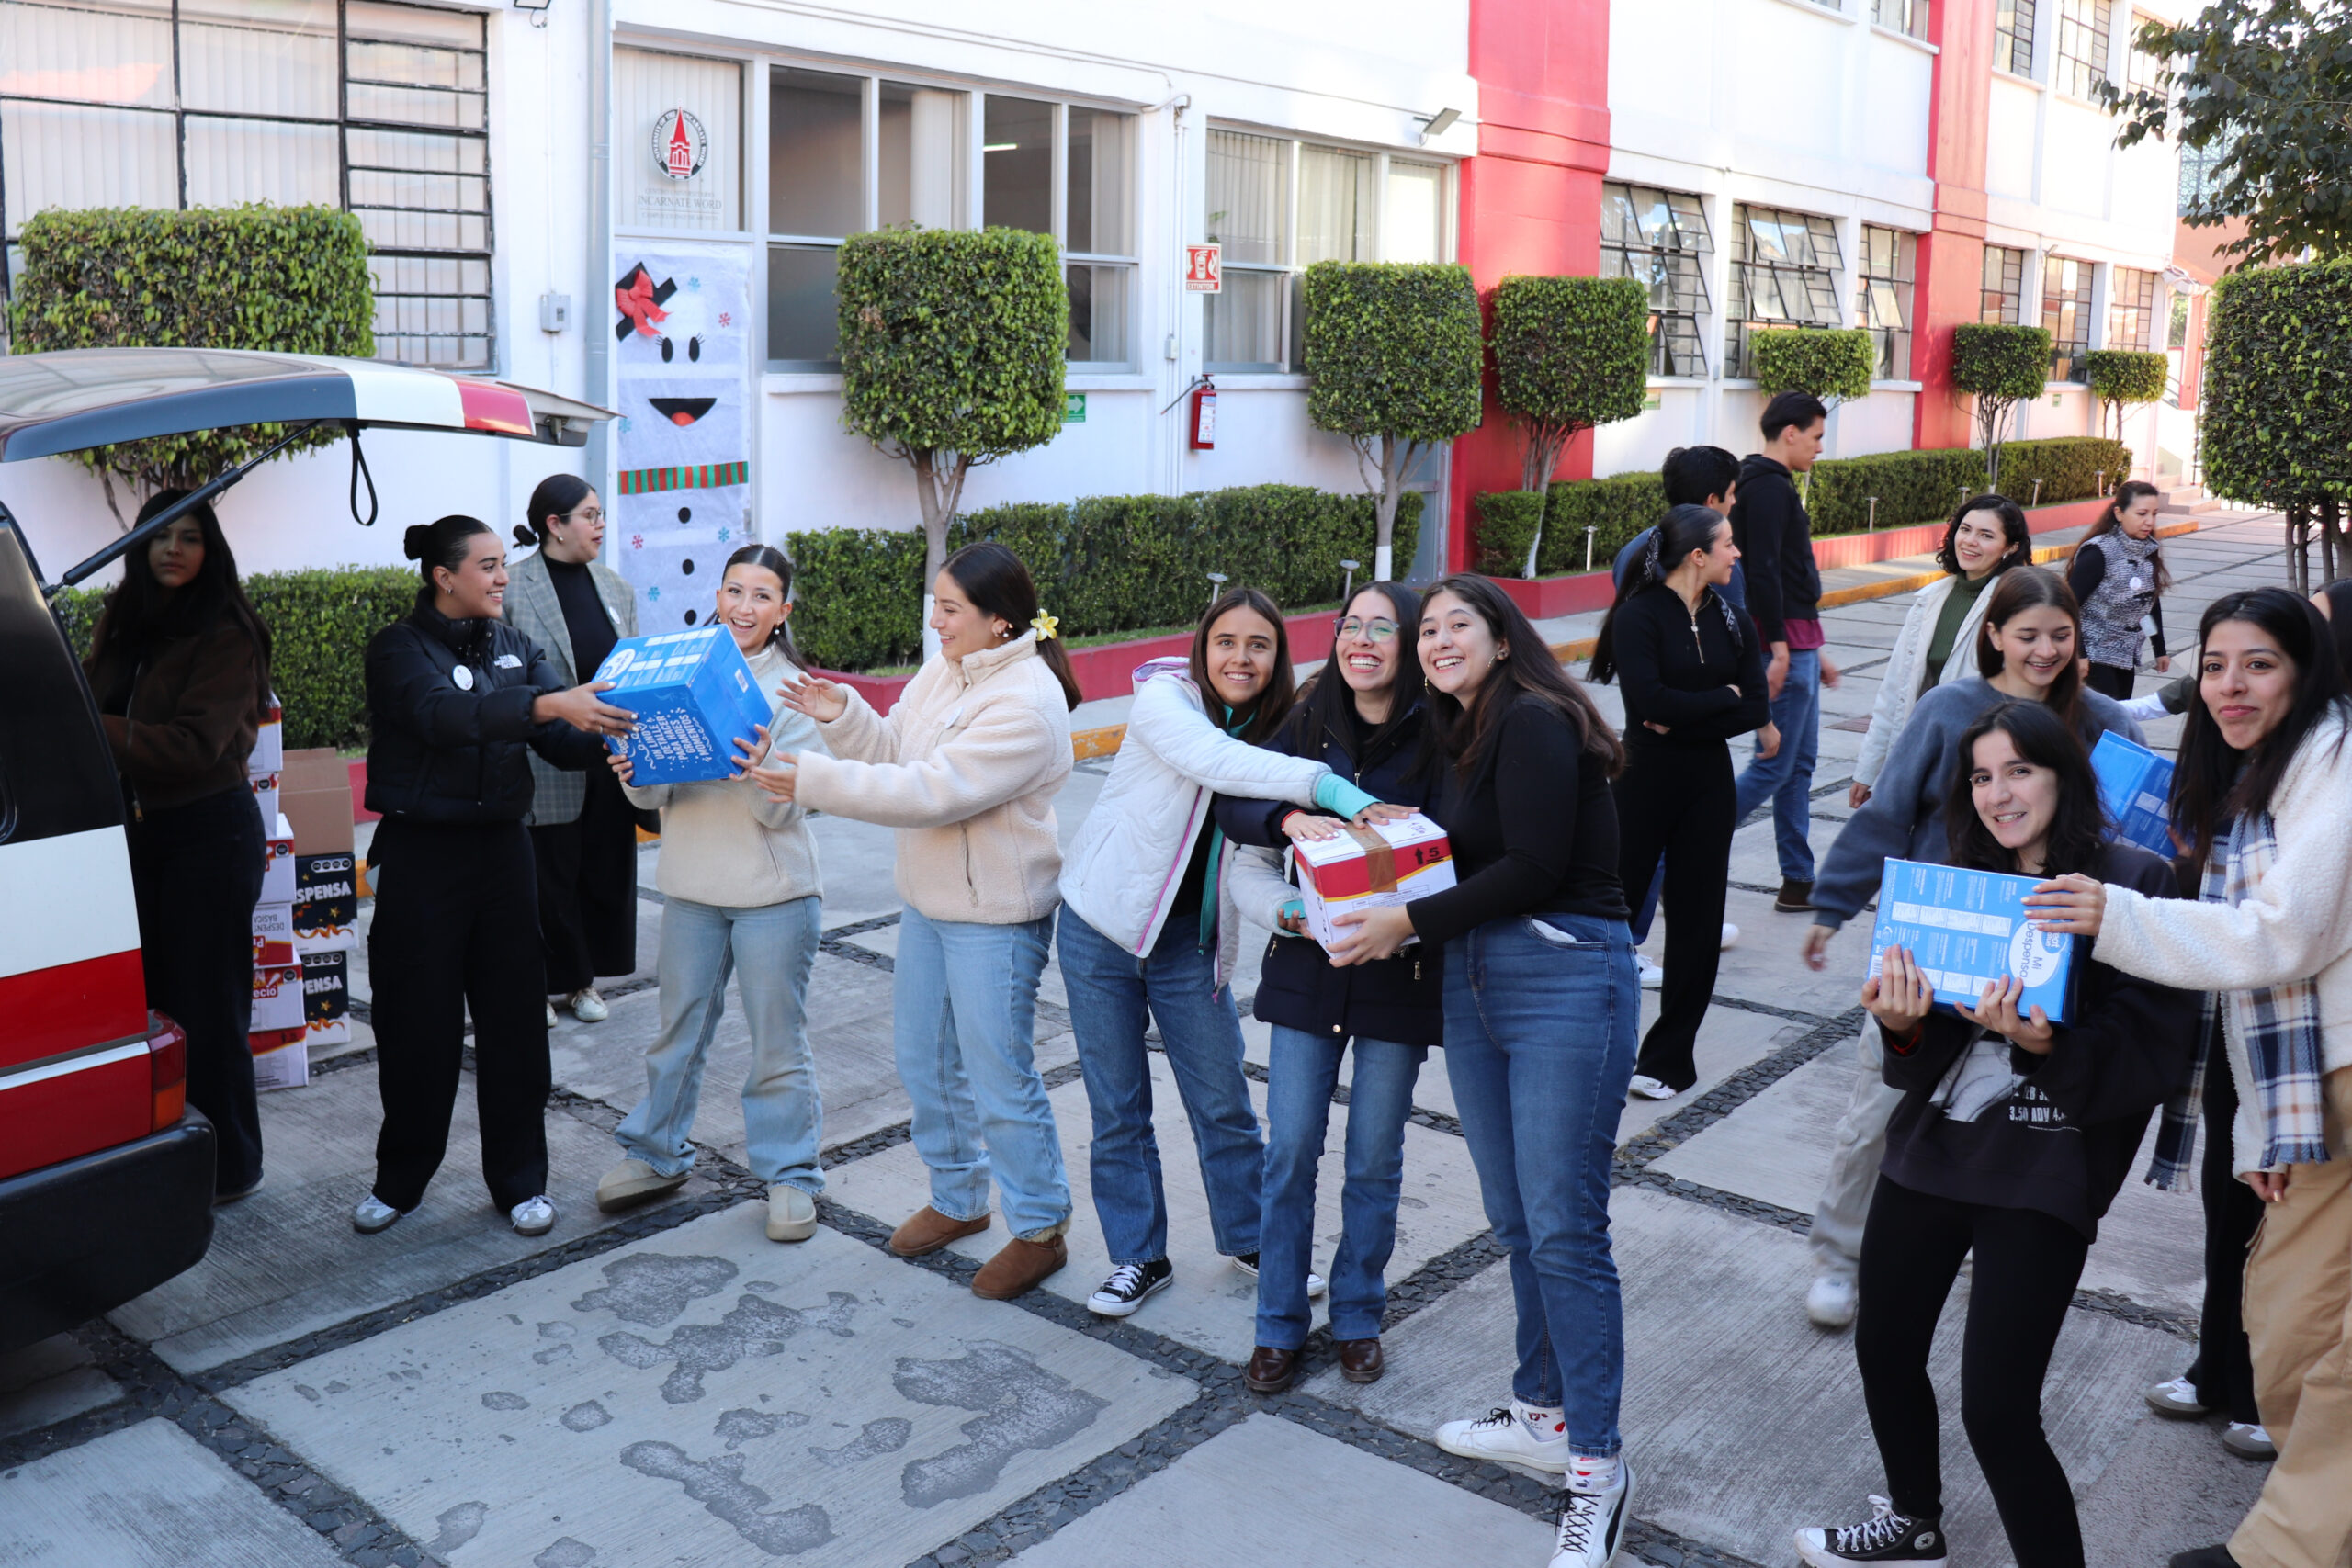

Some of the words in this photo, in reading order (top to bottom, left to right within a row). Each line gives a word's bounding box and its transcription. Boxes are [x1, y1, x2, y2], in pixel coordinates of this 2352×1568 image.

[637, 195, 691, 208] INCARNATE
[693, 197, 722, 209] WORD
[1187, 282, 1215, 290] EXTINTOR
[655, 715, 677, 740] HACER
[670, 719, 695, 754] GRANDES
[679, 714, 710, 757] MOMENTOS
[649, 724, 673, 755] DETALLE
[651, 749, 665, 760] UN
[671, 740, 688, 761] PARA
[293, 881, 351, 904] SPENSA
[253, 922, 285, 932] DESPEN
[2019, 922, 2037, 978] Despensa
[2031, 956, 2043, 970] Mi
[301, 975, 343, 995] ENSA
[2031, 1107, 2050, 1122] ADV
